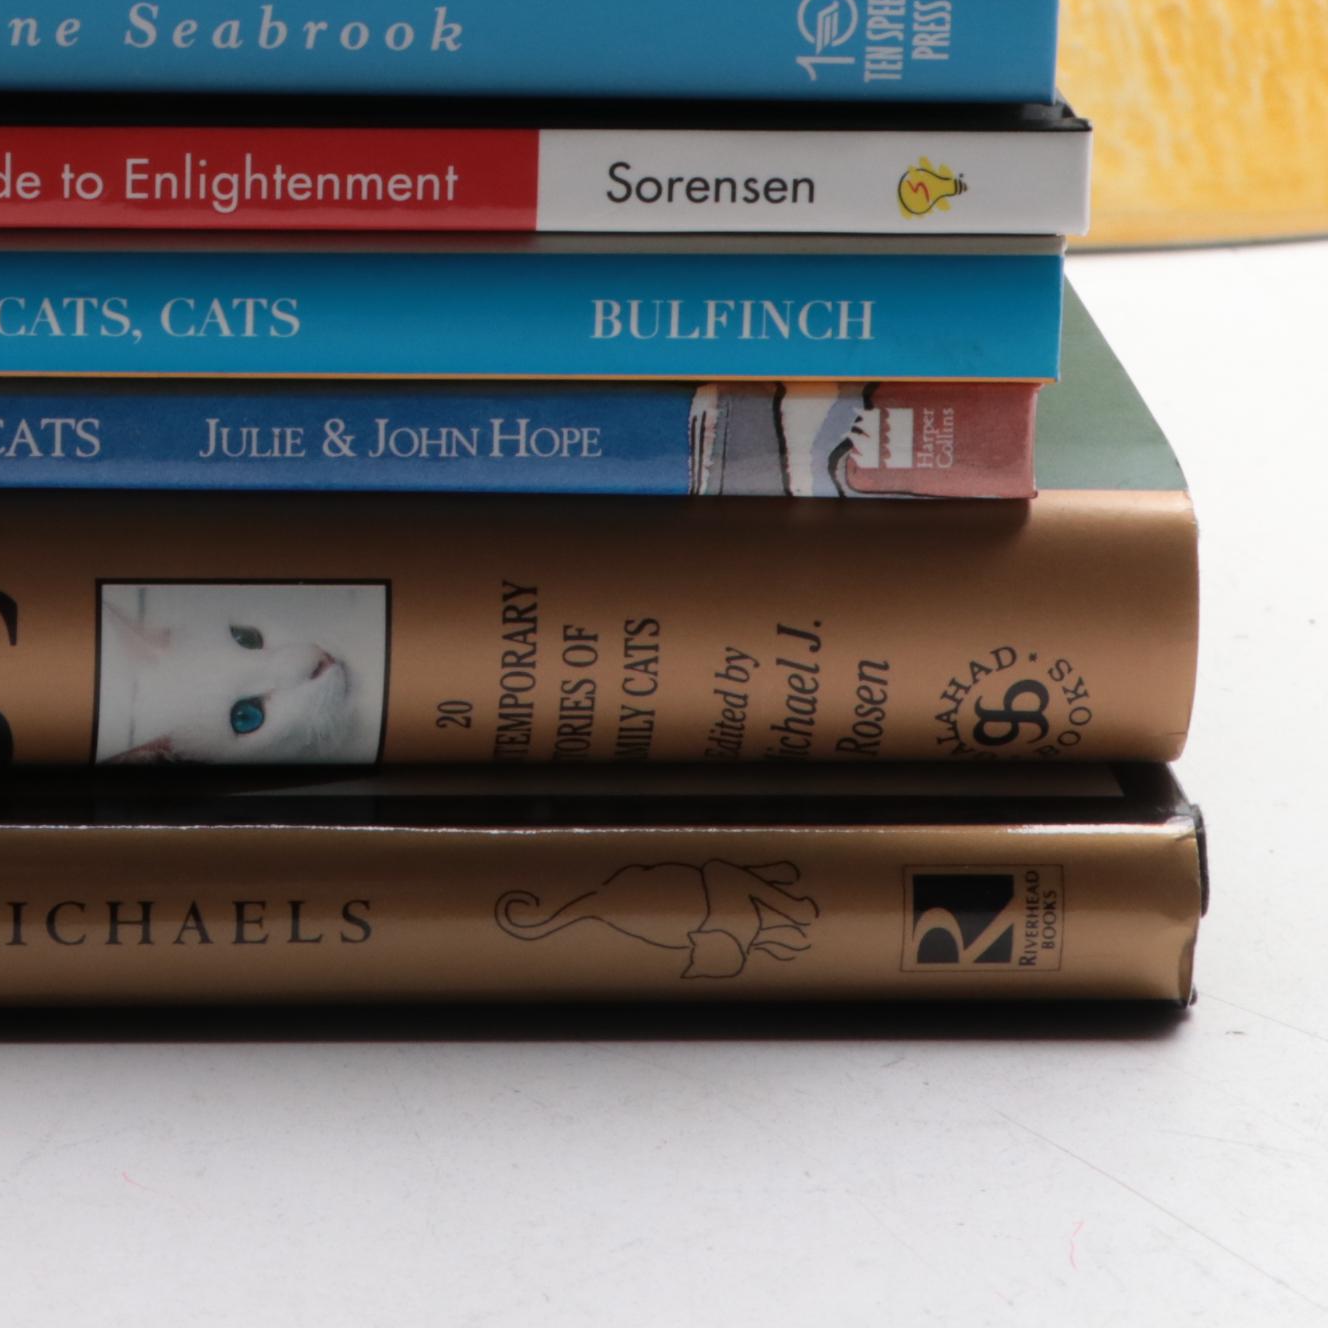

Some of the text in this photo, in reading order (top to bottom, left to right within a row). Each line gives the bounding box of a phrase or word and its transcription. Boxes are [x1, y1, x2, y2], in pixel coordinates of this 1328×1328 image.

[124, 2, 463, 52] Seabrook
[911, 0, 952, 60] PRESS
[864, 46, 903, 83] TEN
[61, 163, 104, 201] to
[125, 153, 458, 213] Enlightenment
[606, 162, 816, 204] Sorensen
[160, 297, 301, 339] CATS
[590, 299, 877, 341] BULFINCH
[321, 418, 357, 458] &
[916, 408, 940, 468] Harper
[936, 408, 955, 469] Collins
[561, 624, 600, 668] OF
[621, 617, 661, 697] CATS
[776, 620, 822, 653] J.
[714, 646, 760, 684] by
[435, 700, 474, 729] 20
[835, 659, 890, 756] Rosen
[1041, 890, 1057, 949] BOOKS
